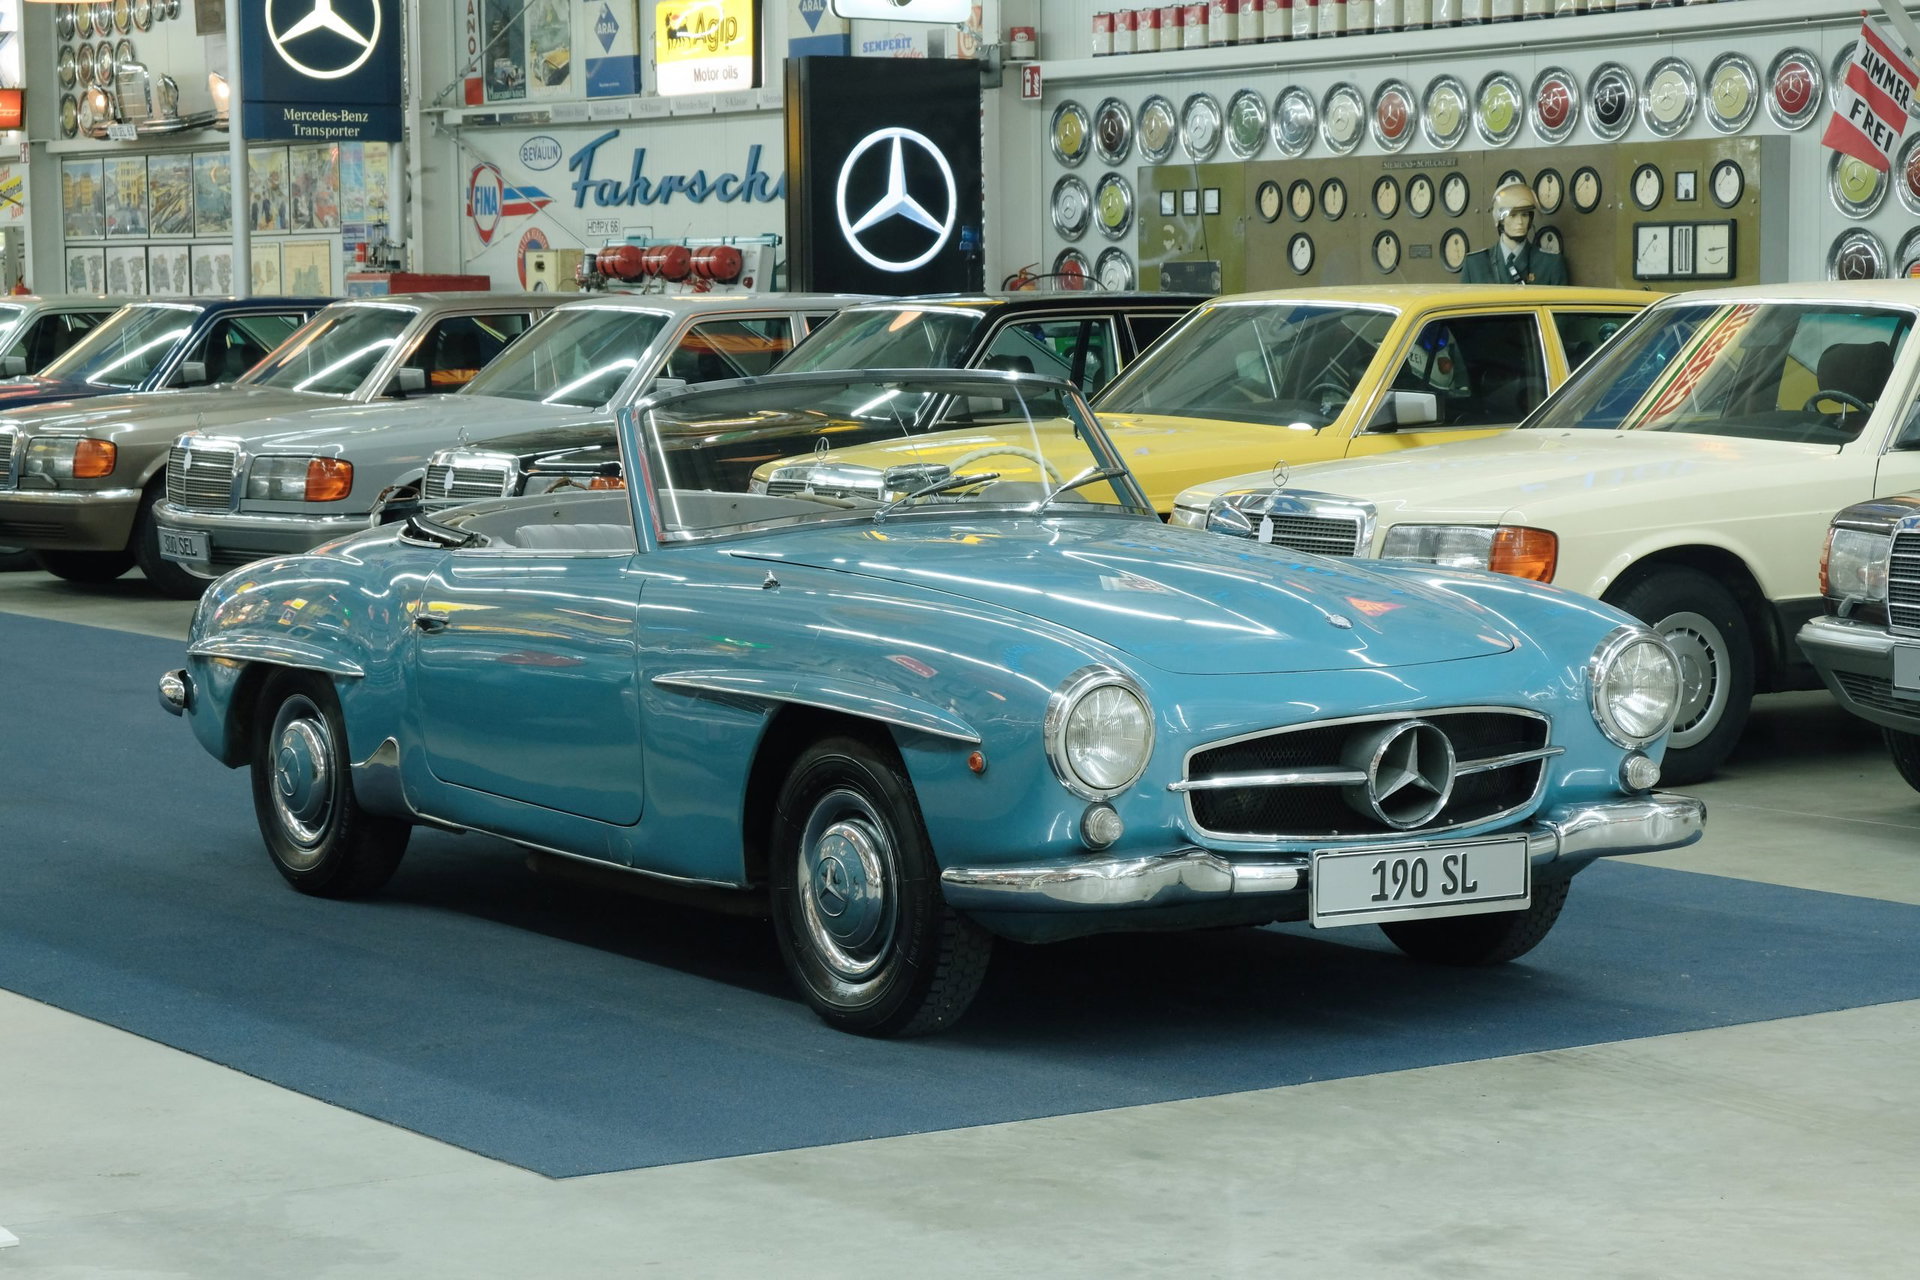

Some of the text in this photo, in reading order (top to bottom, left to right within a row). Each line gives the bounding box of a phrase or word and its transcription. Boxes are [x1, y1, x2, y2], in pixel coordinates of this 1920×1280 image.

[801, 1, 824, 12] ARAL
[596, 24, 617, 35] ARAL
[692, 13, 738, 53] Agip
[862, 37, 912, 53] SEMPERIT
[693, 65, 739, 82] Motor oils
[1860, 44, 1910, 110] ZIMMER
[283, 107, 369, 123] Mercedes-Benz
[292, 123, 360, 139] Transporter
[1849, 98, 1894, 153] FREI
[474, 186, 498, 216] FINA
[178, 536, 198, 557] SEL
[1371, 852, 1478, 902] 190 SL
